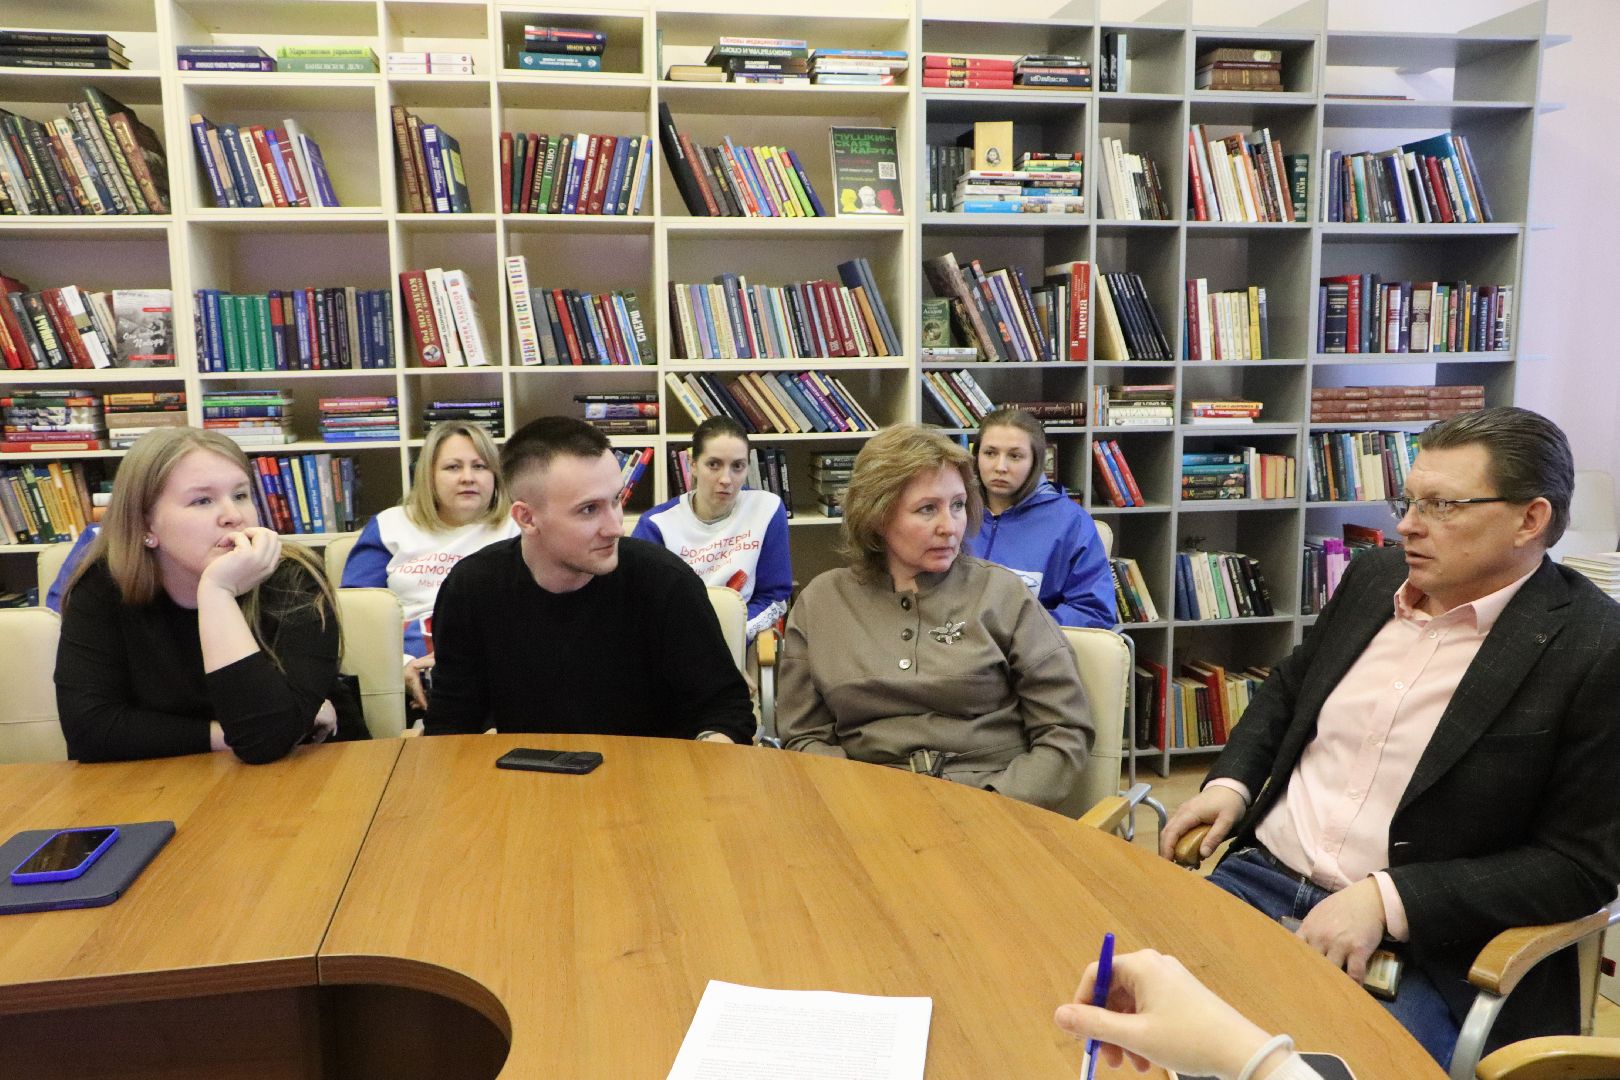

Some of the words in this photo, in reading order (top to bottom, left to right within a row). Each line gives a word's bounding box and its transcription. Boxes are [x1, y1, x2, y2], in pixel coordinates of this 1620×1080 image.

[546, 148, 555, 173] ПРАВО
[630, 310, 646, 342] СМЕРШ
[686, 540, 760, 565] МОСКВЬЯ
